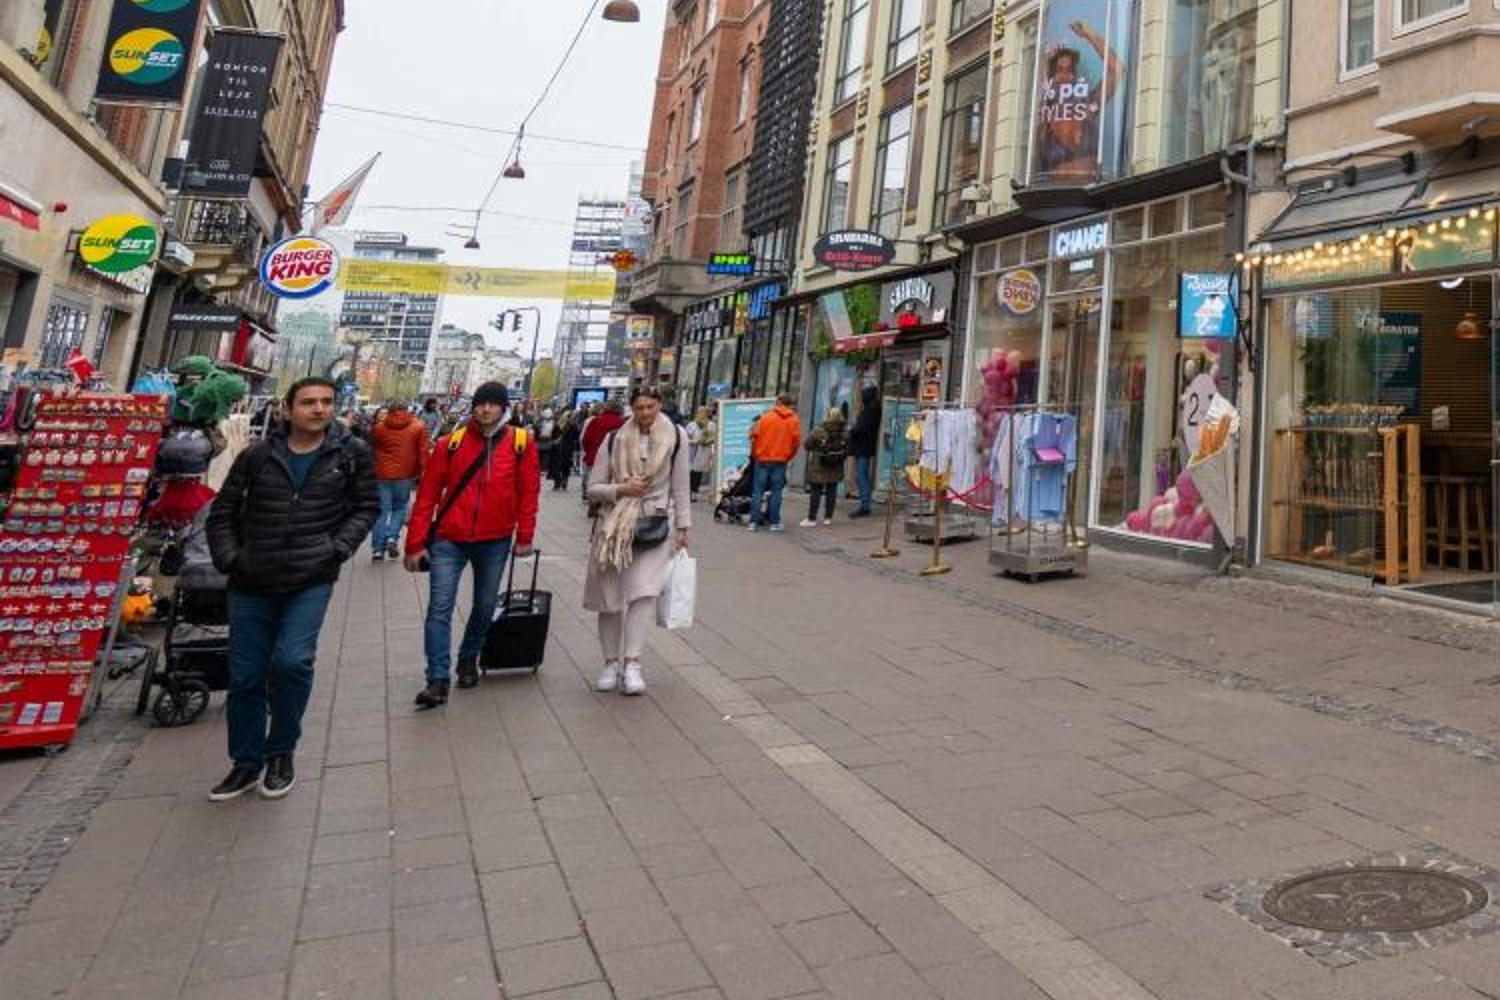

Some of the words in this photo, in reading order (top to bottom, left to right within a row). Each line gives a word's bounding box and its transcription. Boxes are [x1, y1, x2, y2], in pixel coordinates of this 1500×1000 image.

[112, 49, 183, 64] SUNSET
[1060, 77, 1089, 104] på
[82, 237, 155, 250] SUNSET
[271, 249, 333, 266] BURGER
[269, 260, 333, 281] KING
